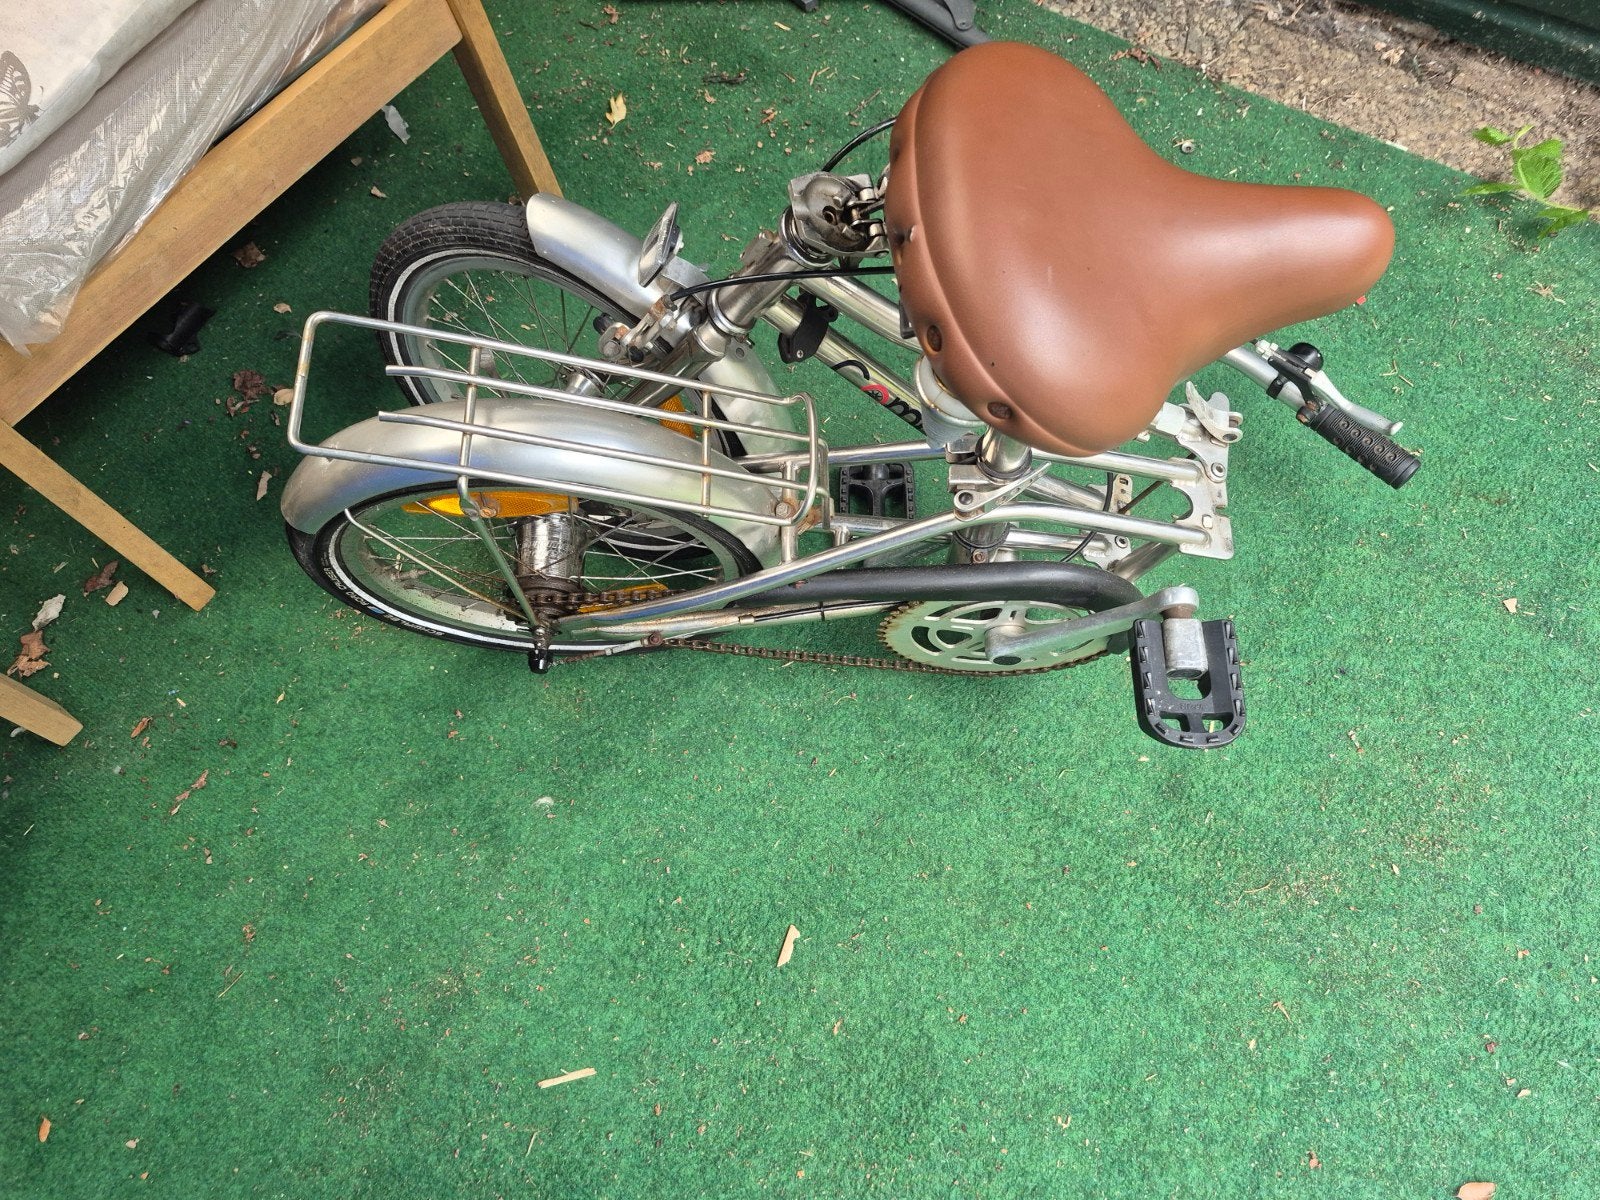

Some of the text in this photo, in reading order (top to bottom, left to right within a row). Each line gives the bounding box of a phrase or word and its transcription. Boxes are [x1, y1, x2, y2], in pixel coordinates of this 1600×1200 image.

[323, 567, 445, 636] SCHWALBE ROAD CRUISER
